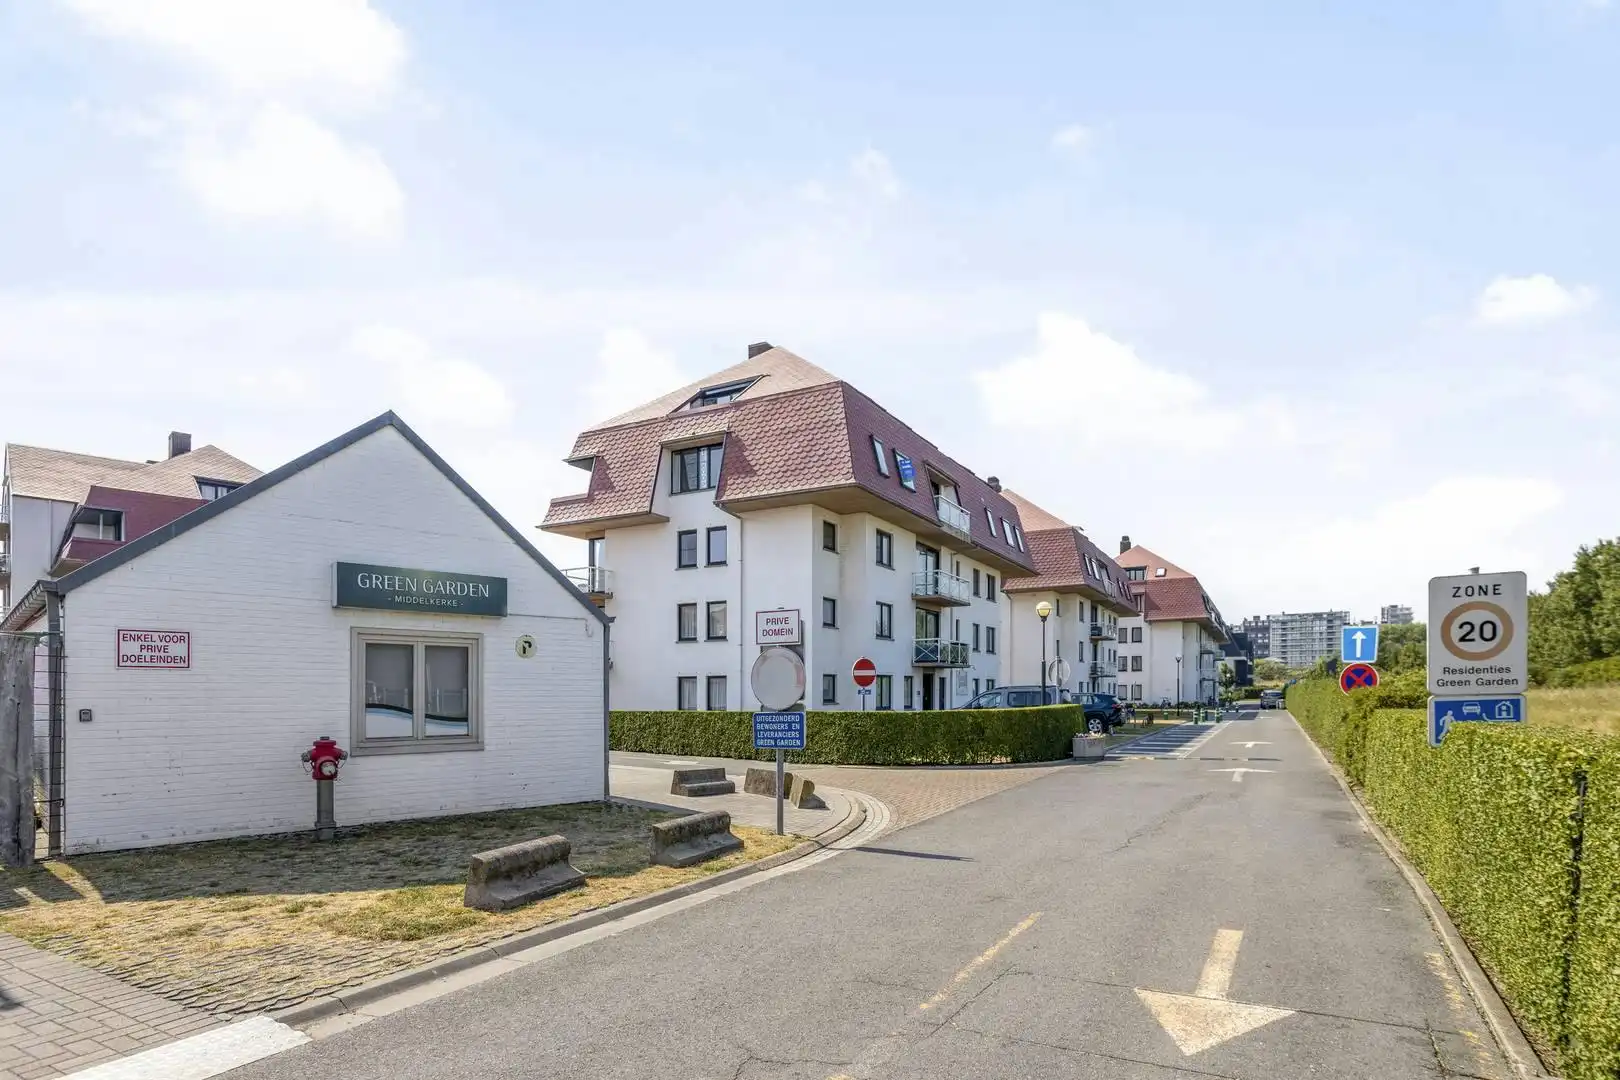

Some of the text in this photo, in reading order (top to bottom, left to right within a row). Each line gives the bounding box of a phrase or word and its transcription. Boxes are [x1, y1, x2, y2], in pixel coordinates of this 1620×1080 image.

[357, 573, 489, 598] GREEN GARDEN
[1452, 584, 1502, 598] ZONE
[394, 595, 458, 607] MIDDELKERKE
[765, 617, 790, 626] PRIVE
[762, 628, 794, 637] DOMEIN
[1458, 620, 1497, 642] 20
[122, 633, 186, 643] ENKEL VOOR
[139, 644, 169, 653] PRIVE
[121, 654, 186, 664] DOELEINDEN
[1443, 665, 1512, 676] Residenties
[1436, 677, 1519, 688] Green Garden
